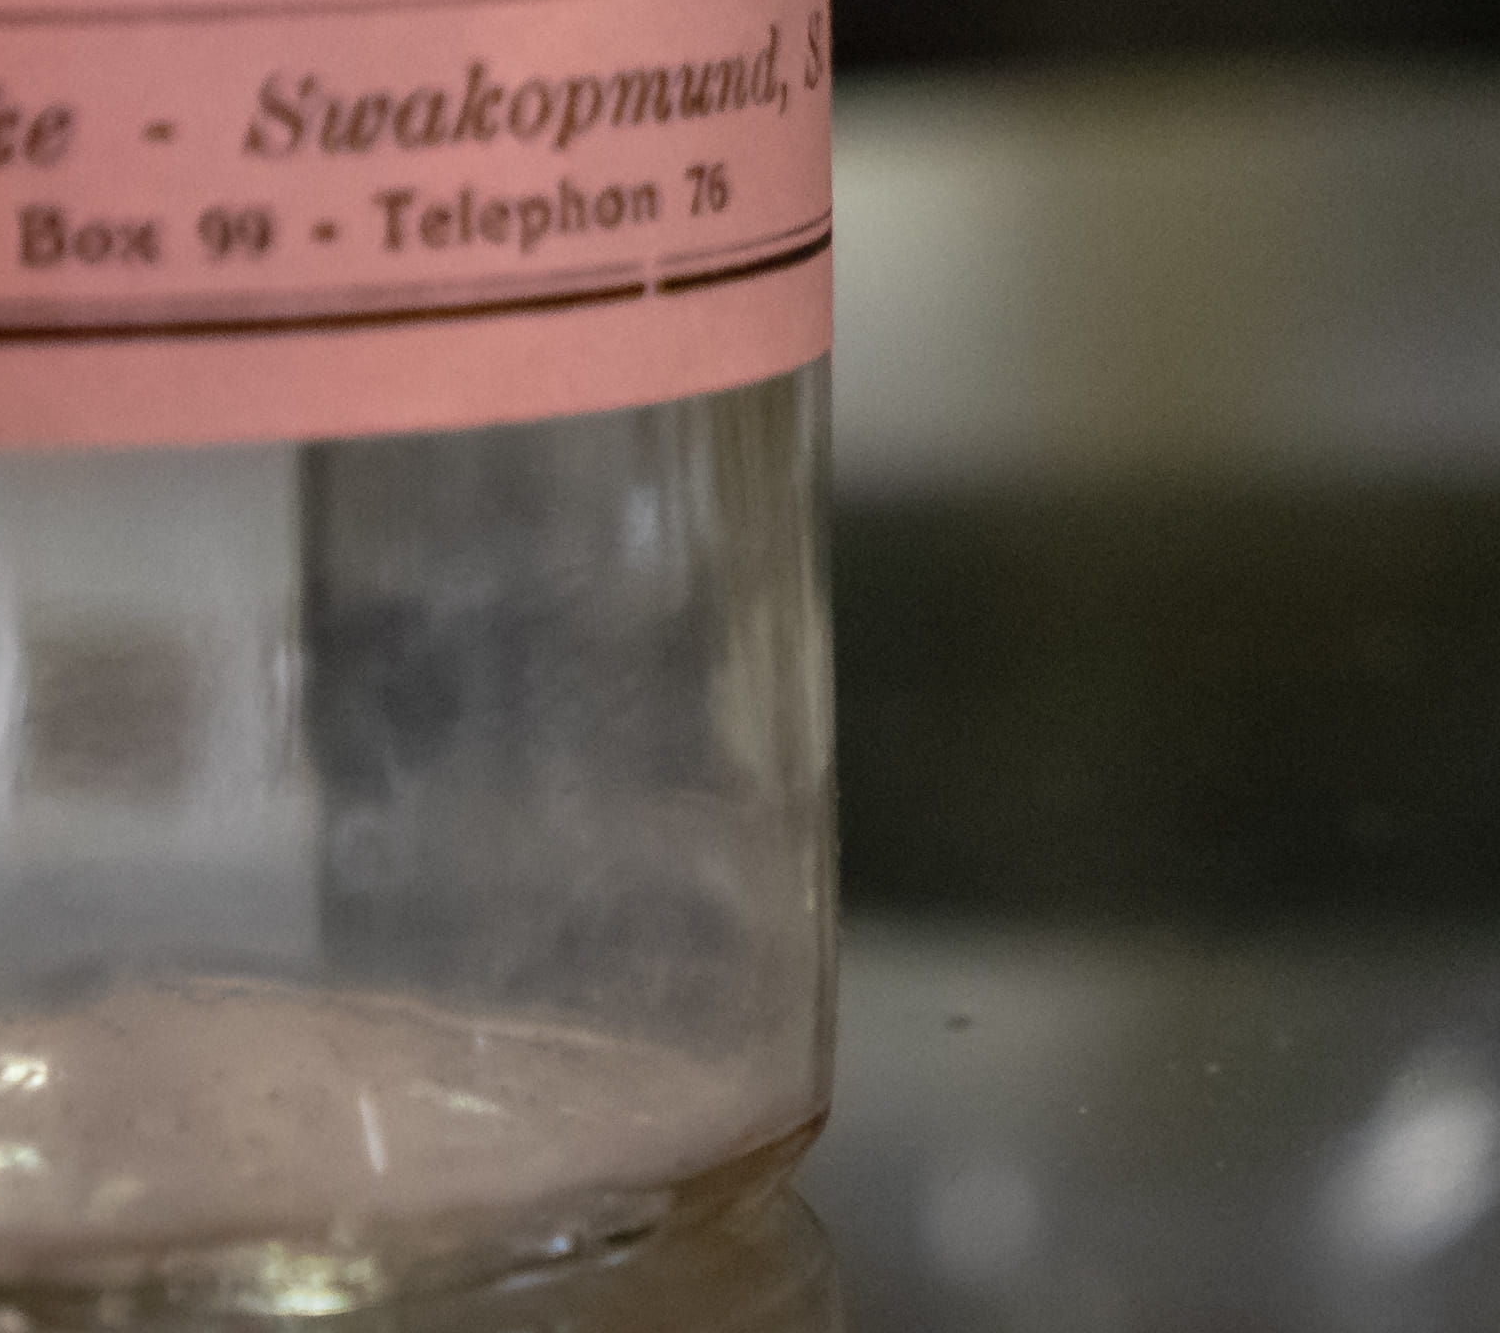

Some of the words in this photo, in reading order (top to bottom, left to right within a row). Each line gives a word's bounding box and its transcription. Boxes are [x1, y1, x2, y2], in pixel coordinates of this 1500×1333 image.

[240, 23, 791, 159] Swakopmund,
[17, 203, 160, 269] Box
[196, 205, 274, 263] 99
[373, 178, 660, 253] Telephon
[683, 161, 732, 217] 76
